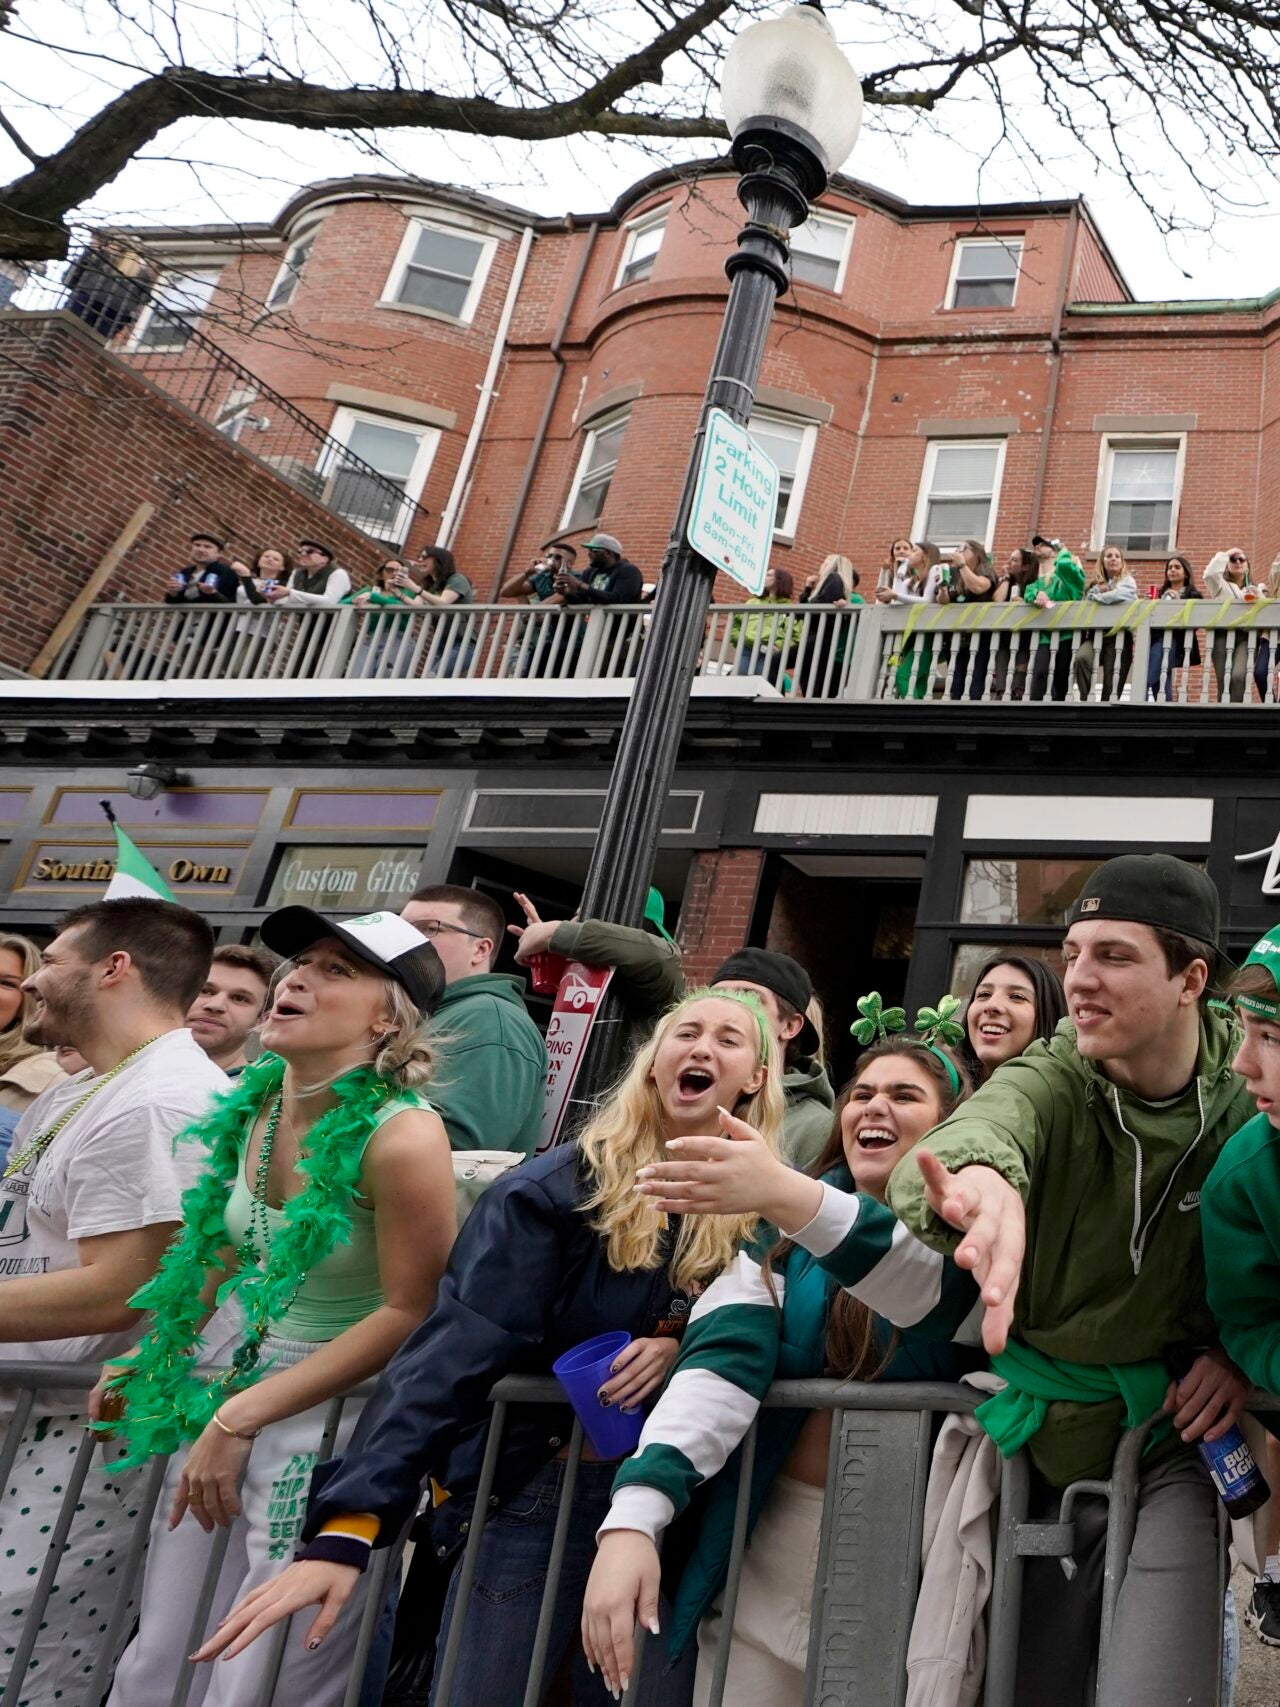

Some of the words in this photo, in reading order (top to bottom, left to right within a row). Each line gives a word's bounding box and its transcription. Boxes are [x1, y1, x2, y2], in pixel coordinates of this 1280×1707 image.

[714, 455, 727, 476] 2
[732, 468, 768, 511] Hour
[717, 483, 758, 529] Limit
[703, 521, 757, 570] 8am-6pm
[712, 511, 755, 553] Mon-Fri
[32, 857, 118, 881] Southi
[168, 858, 231, 882] Own
[283, 859, 358, 892] Custom
[366, 859, 420, 893] Gifts
[546, 1040, 573, 1055] PING
[1184, 1191, 1201, 1202] NIK
[1223, 1442, 1250, 1470] BUD
[1223, 1456, 1256, 1484] LIGH
